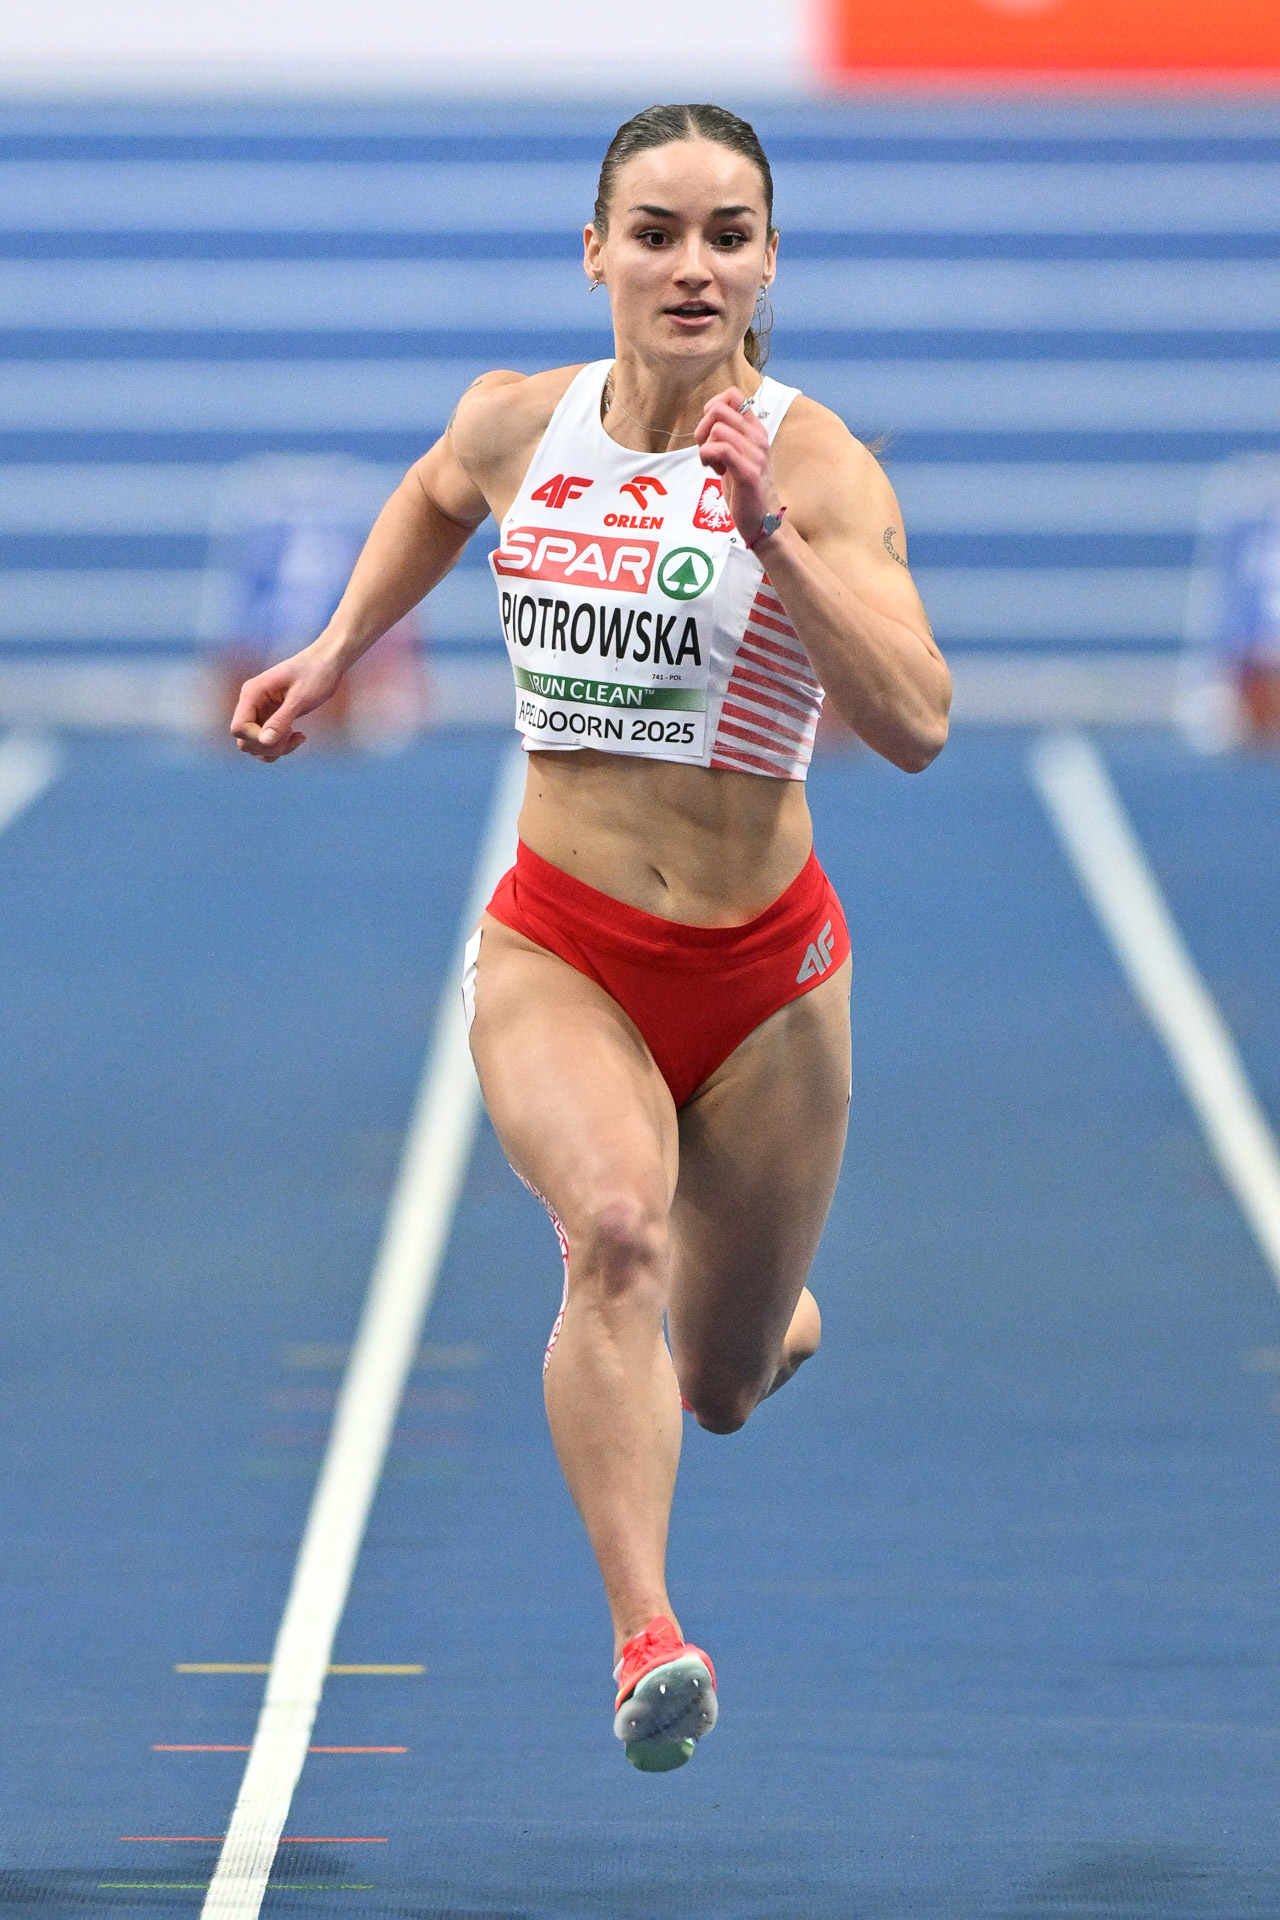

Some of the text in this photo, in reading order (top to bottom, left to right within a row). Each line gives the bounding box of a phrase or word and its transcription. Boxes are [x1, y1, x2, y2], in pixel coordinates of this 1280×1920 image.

[531, 473, 594, 509] 4F
[603, 513, 664, 530] ORLEN
[497, 532, 651, 586] SPAR
[502, 591, 702, 667] PIOTROWSKA
[518, 700, 696, 744] APELDOORN 2025
[796, 918, 835, 985] 4F
